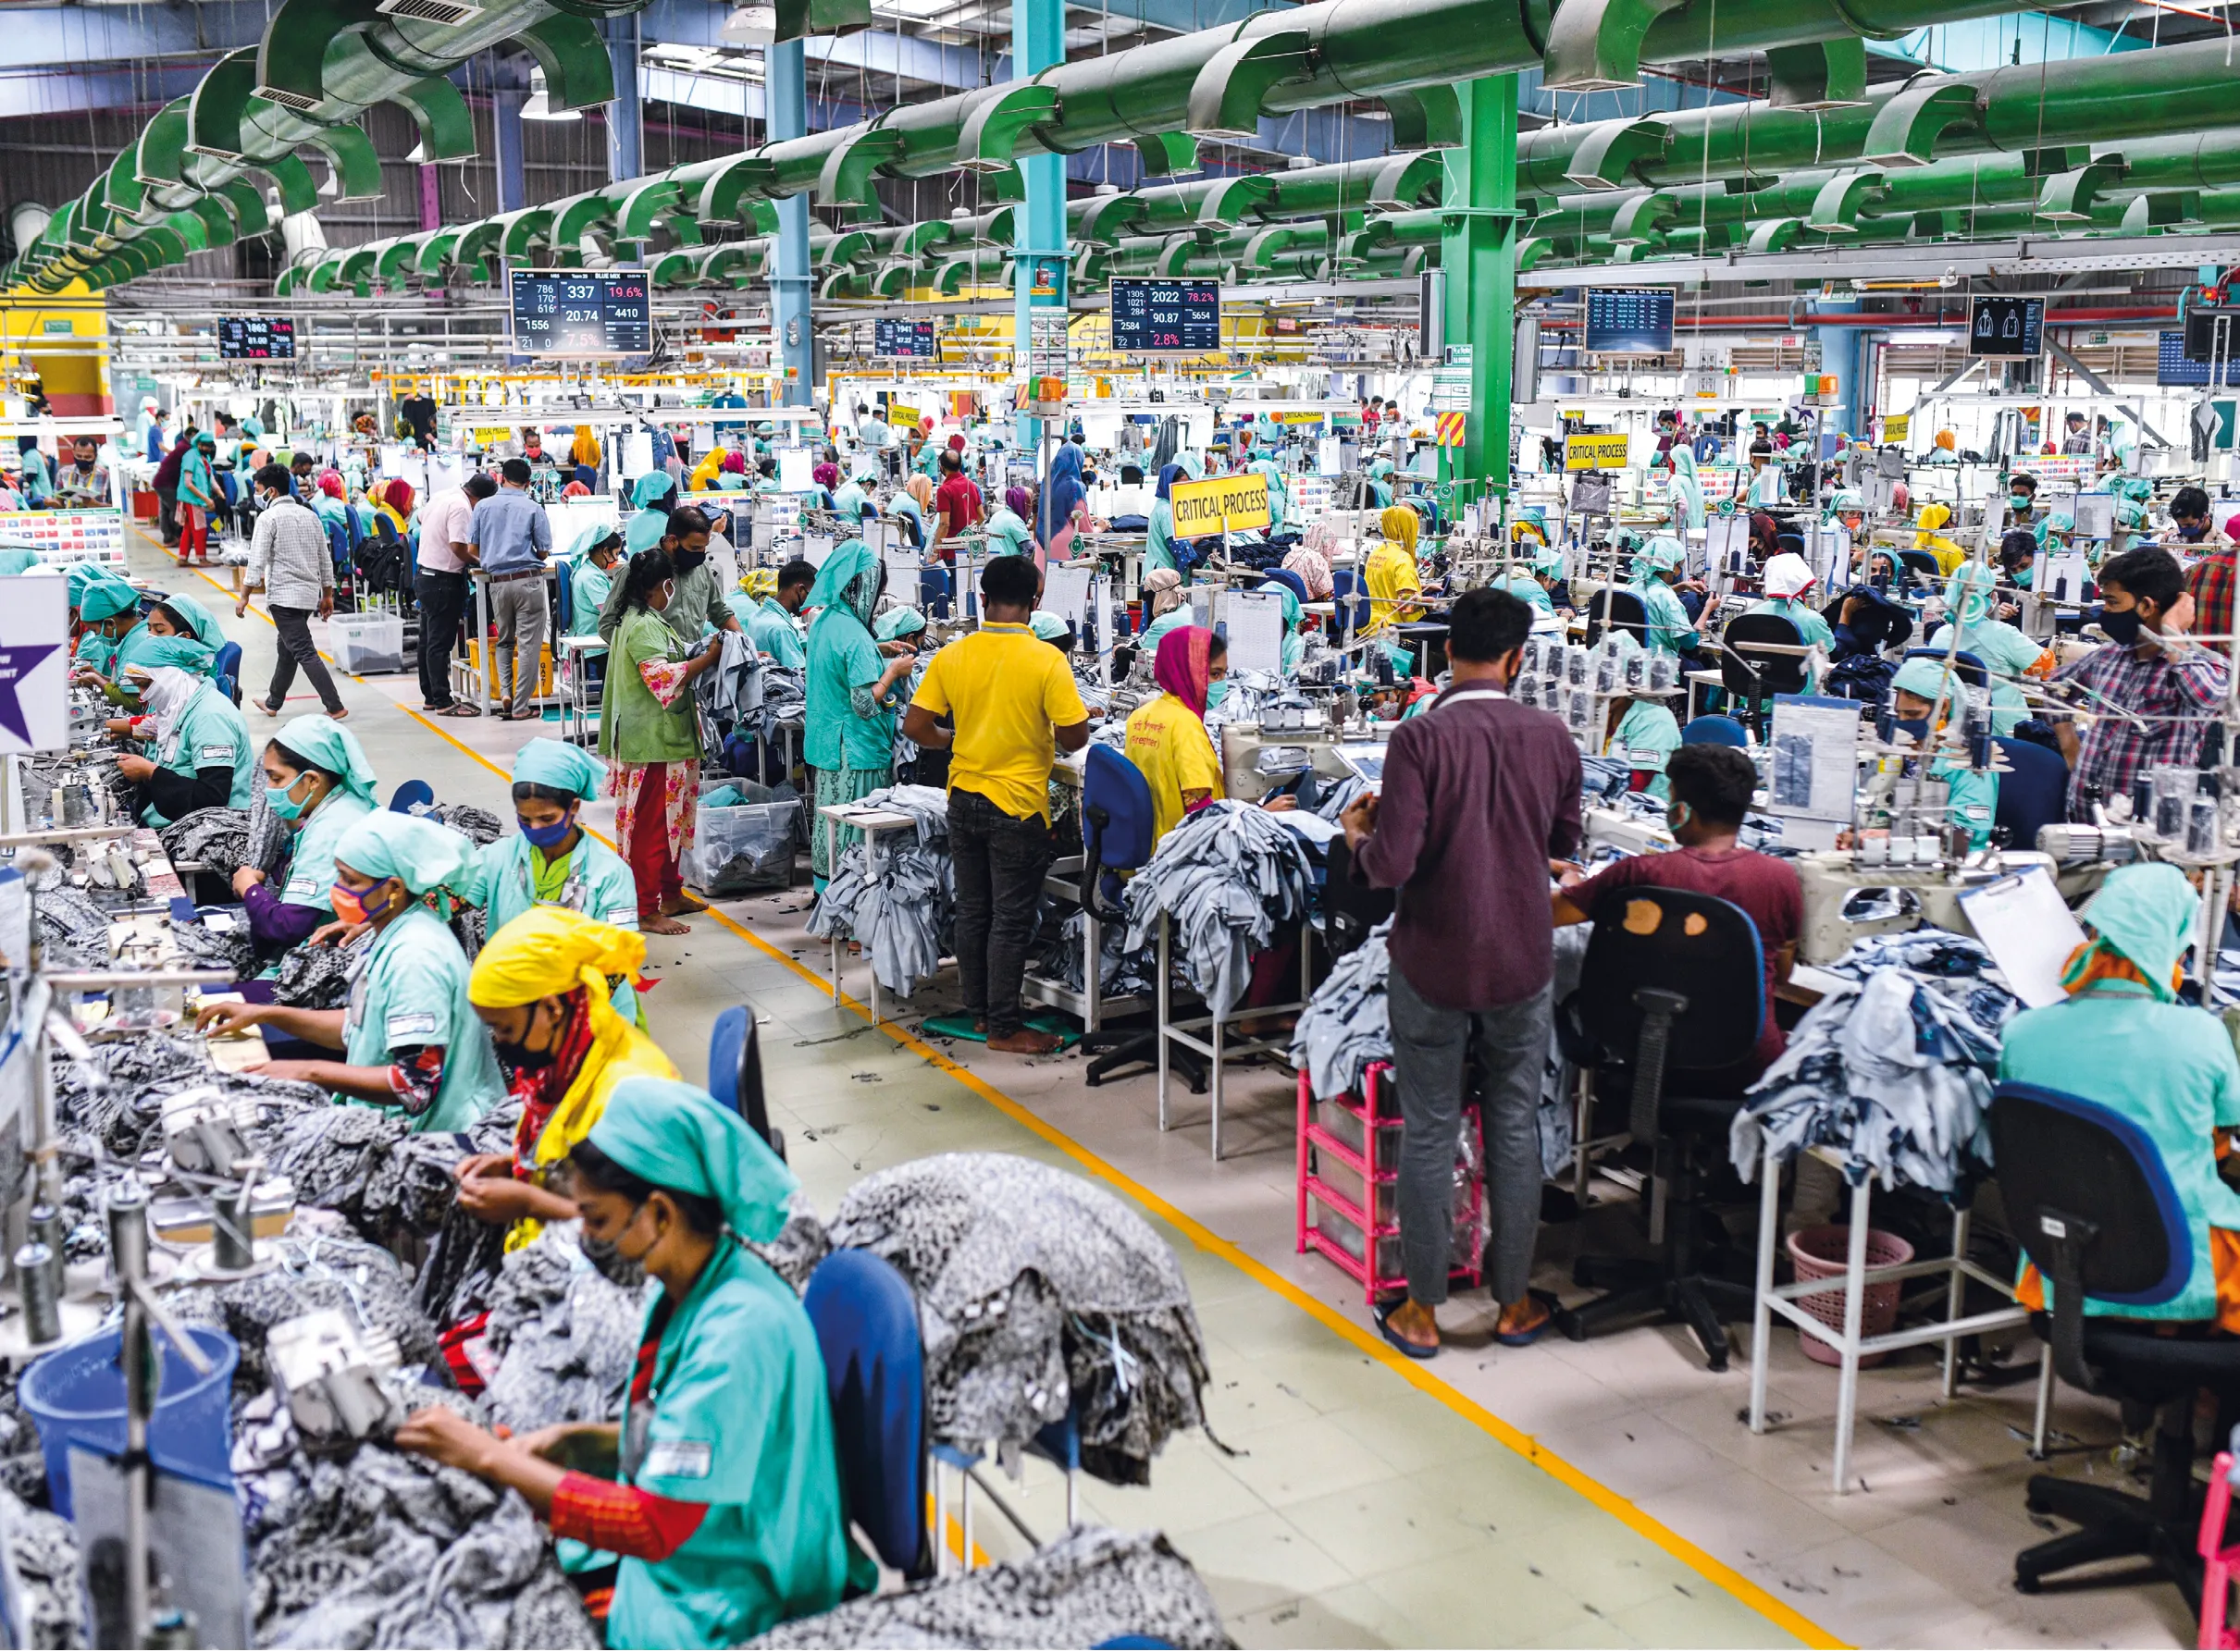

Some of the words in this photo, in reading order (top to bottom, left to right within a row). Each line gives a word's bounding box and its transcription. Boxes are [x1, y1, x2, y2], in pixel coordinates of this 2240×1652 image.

[537, 285, 554, 293] 786
[567, 286, 595, 299] 337
[609, 287, 643, 298] 19.6%
[1152, 291, 1180, 302] 2022
[1187, 292, 1215, 302] 78.2%
[538, 304, 554, 313] 616
[615, 308, 638, 317] 4410
[565, 310, 599, 322] 20.74
[1153, 313, 1179, 324] 90.87
[1192, 312, 1210, 320] 5654
[526, 320, 550, 329] 1556
[1120, 322, 1140, 330] 2584
[522, 339, 533, 348] 21
[545, 339, 551, 348] 0
[566, 334, 600, 347] 7.5%
[1118, 338, 1128, 346] 22
[1154, 334, 1179, 345] 2.8%
[1568, 446, 1596, 460] CRITICAL
[1597, 444, 1627, 459] PROCESS
[1176, 496, 1221, 522] CRITICAL
[1223, 488, 1267, 515] PROCESS
